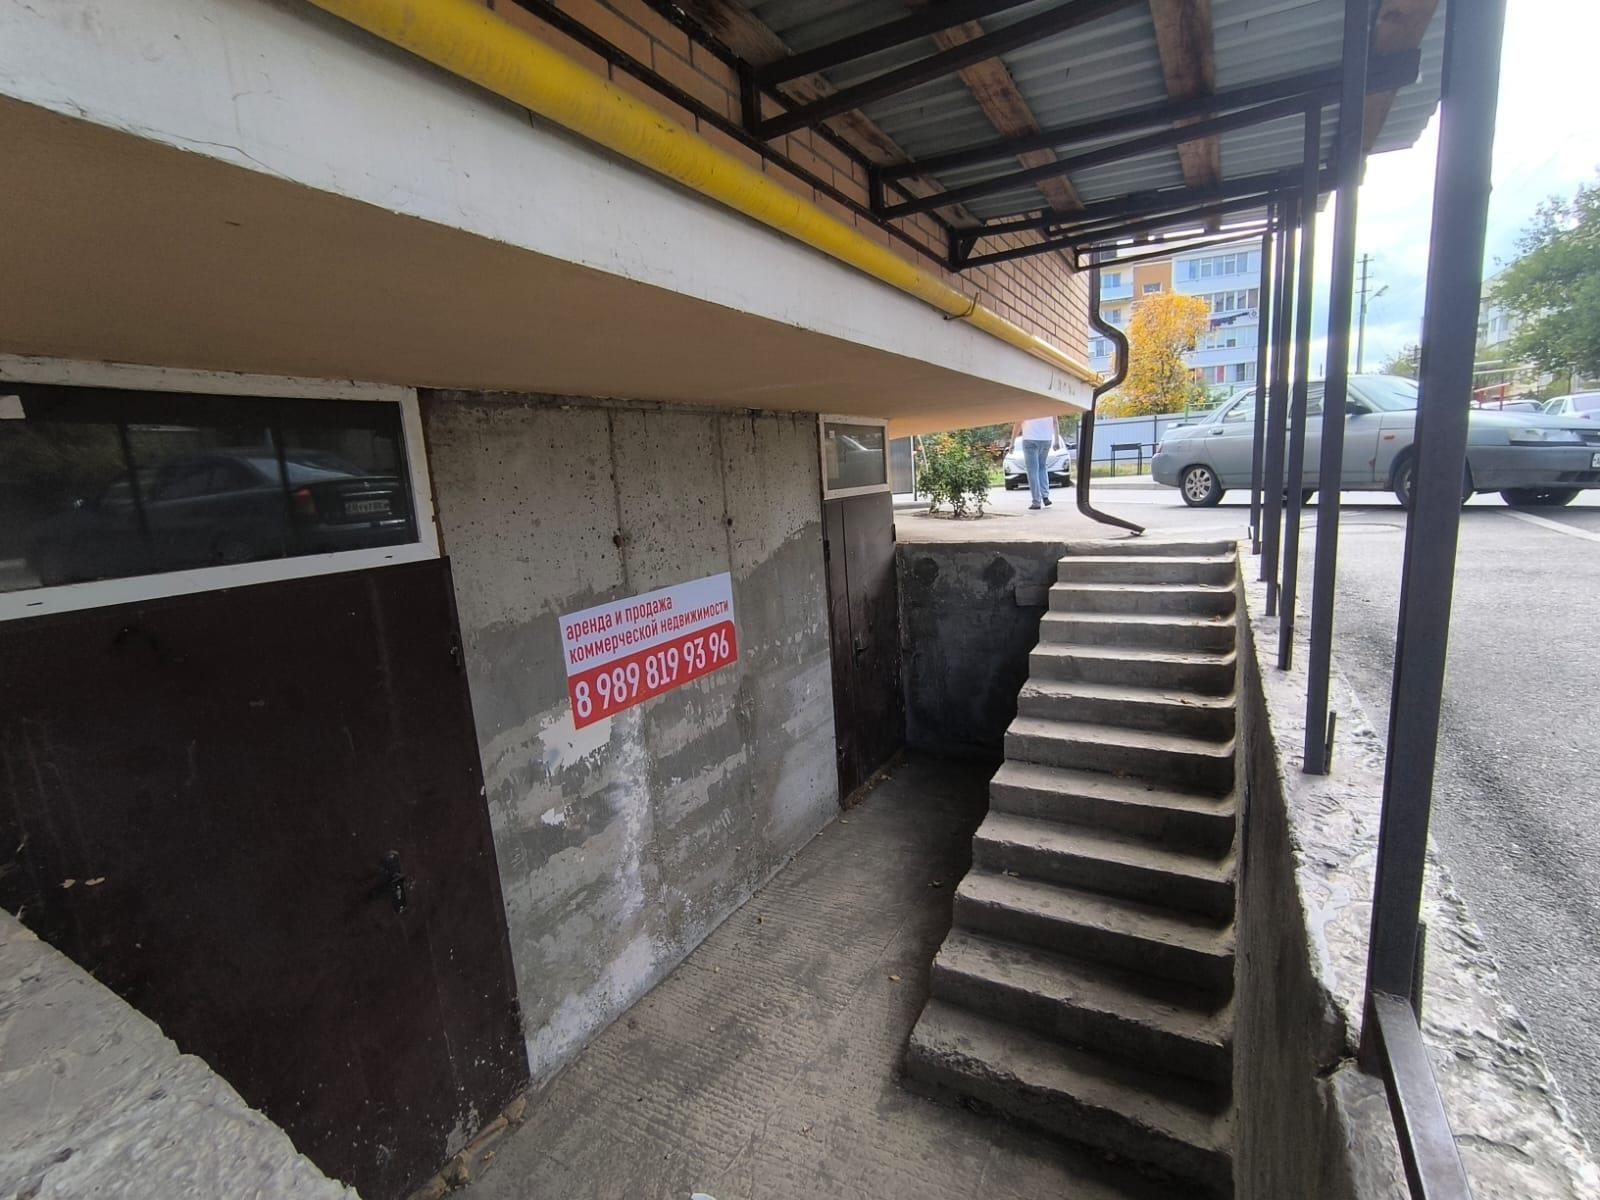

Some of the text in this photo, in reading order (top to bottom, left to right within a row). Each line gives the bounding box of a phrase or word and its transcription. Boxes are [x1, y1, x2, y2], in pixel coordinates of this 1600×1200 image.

[566, 597, 673, 642] аренда и продажа
[570, 600, 729, 664] коммерческой недвижимости
[575, 628, 730, 718] 8 989 819 93 96
